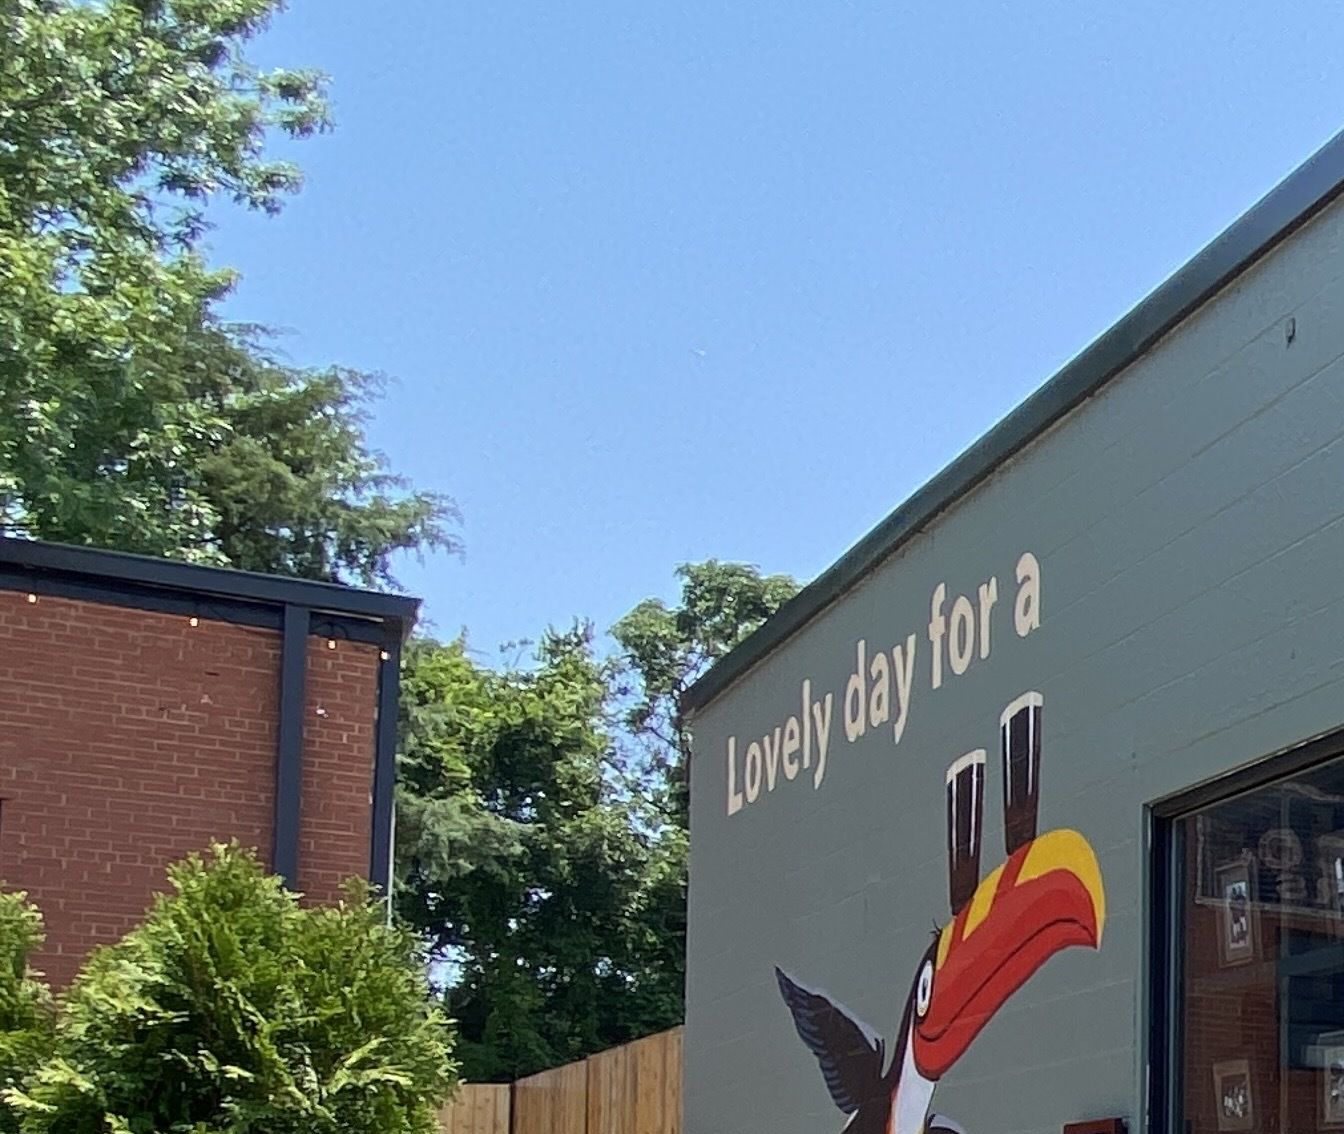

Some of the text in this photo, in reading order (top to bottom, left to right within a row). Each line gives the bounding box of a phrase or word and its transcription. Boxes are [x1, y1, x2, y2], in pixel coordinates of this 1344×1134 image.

[727, 551, 1041, 816] Lovely day for a
